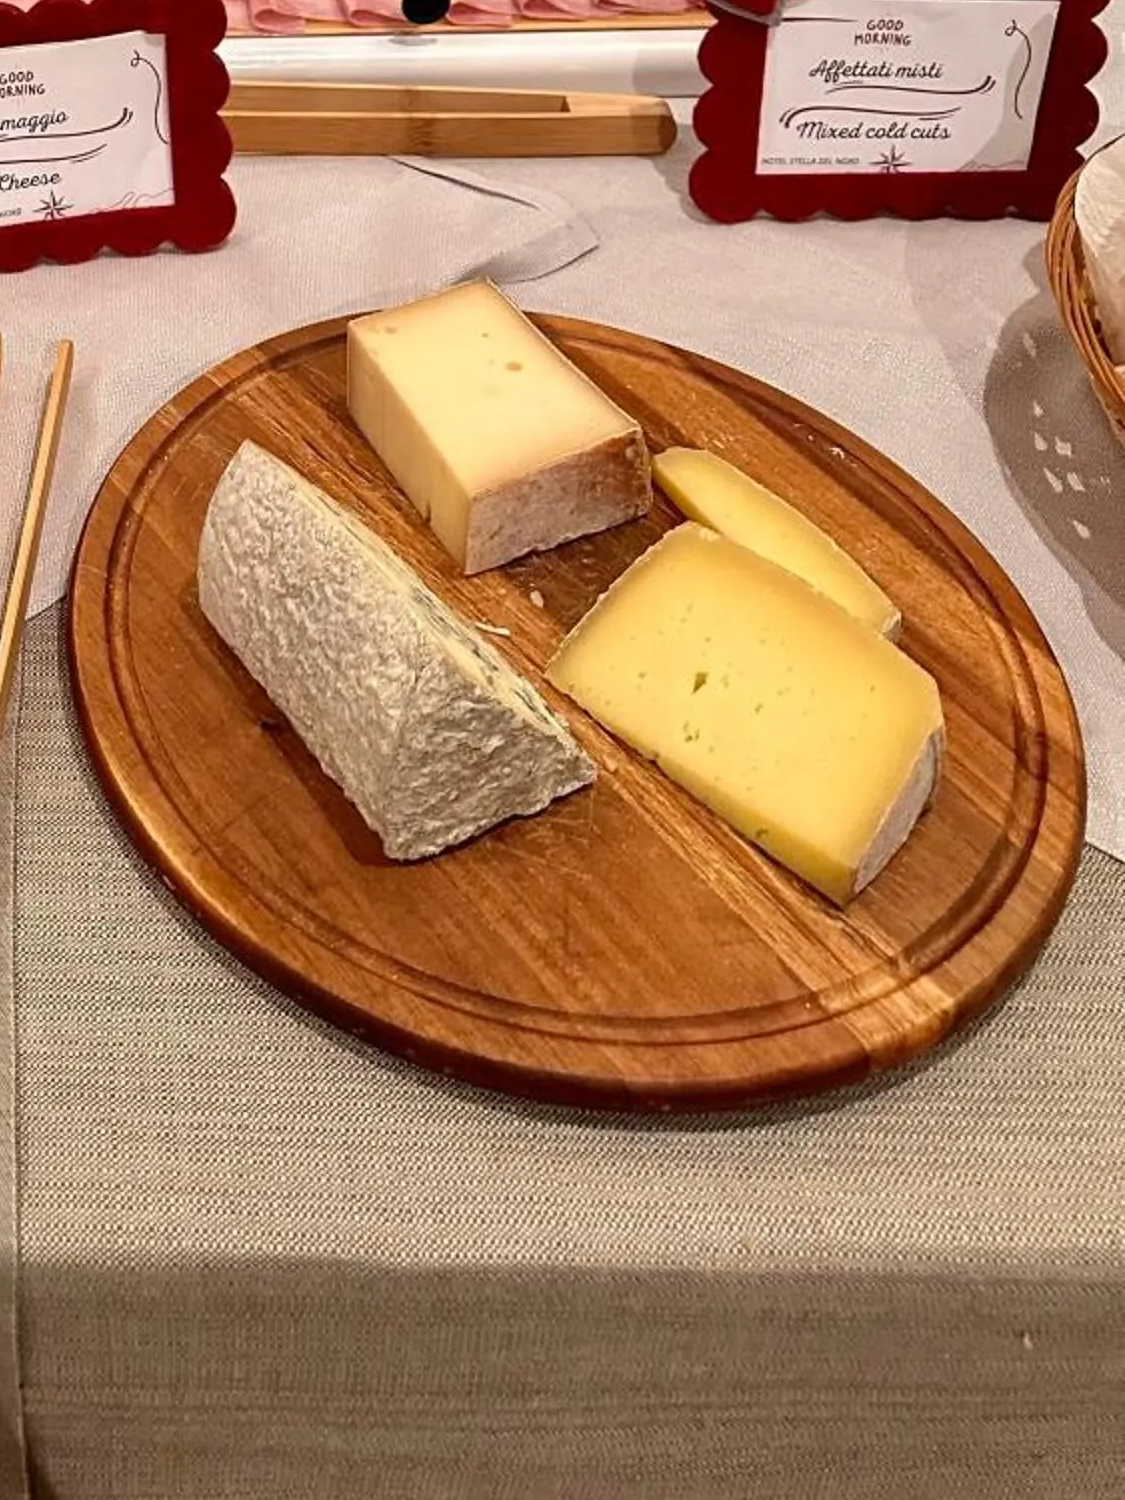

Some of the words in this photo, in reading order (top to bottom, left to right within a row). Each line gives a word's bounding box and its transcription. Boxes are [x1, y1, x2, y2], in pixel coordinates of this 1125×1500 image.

[865, 19, 905, 31] GOOD
[854, 32, 912, 46] MORNING
[808, 59, 892, 83] Affettati
[894, 60, 943, 79] misti
[796, 120, 863, 140] Mixed
[865, 121, 907, 139] cold
[910, 123, 951, 140] cuts
